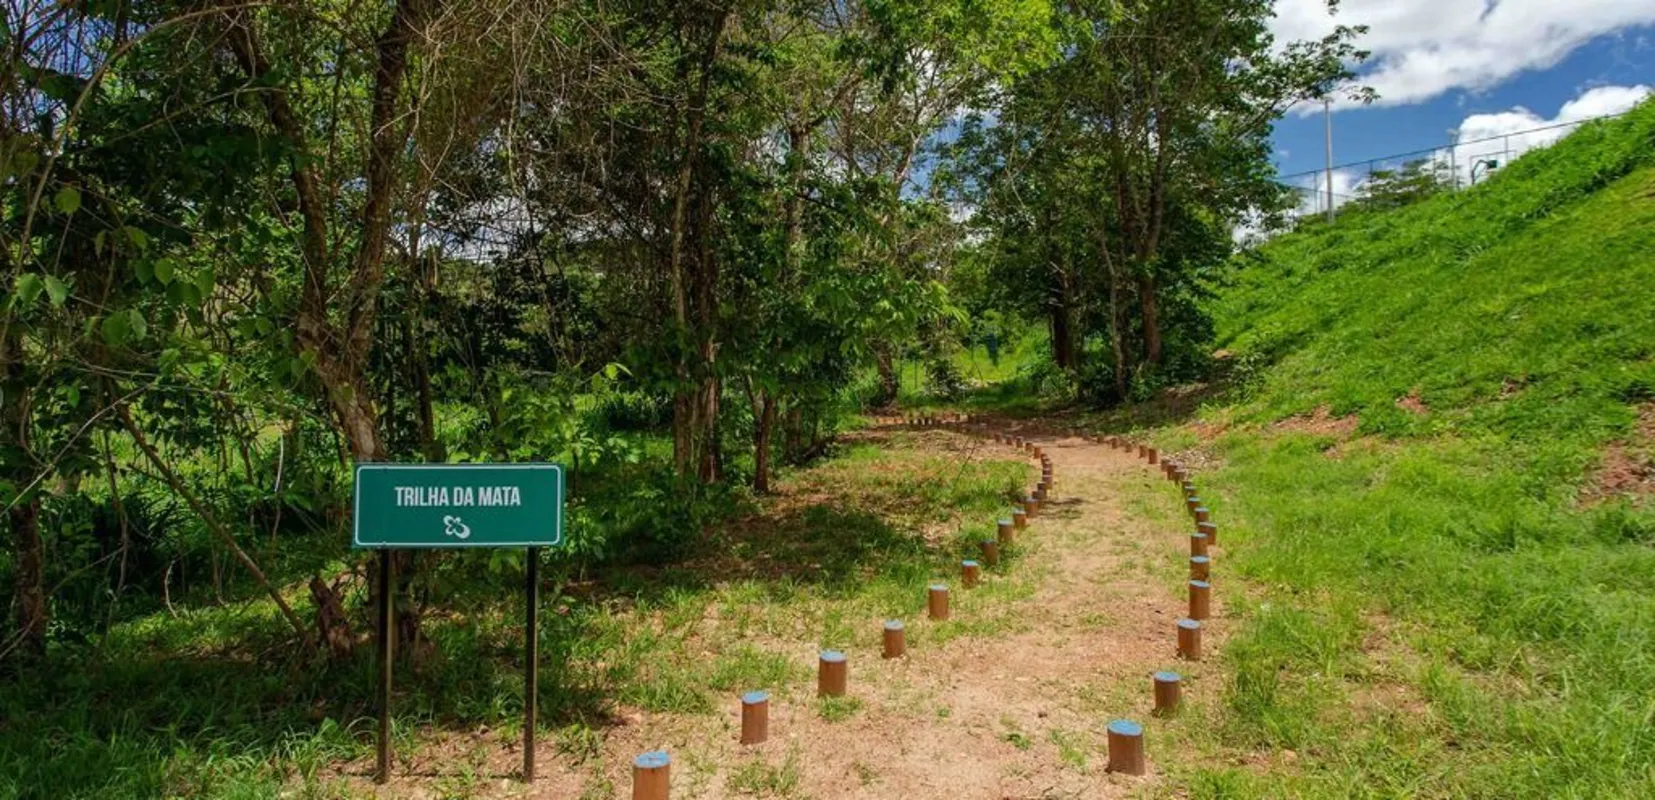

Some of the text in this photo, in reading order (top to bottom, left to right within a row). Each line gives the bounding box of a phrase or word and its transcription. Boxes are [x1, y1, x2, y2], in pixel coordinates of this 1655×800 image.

[395, 486, 521, 506] TRILHA DA MATA
